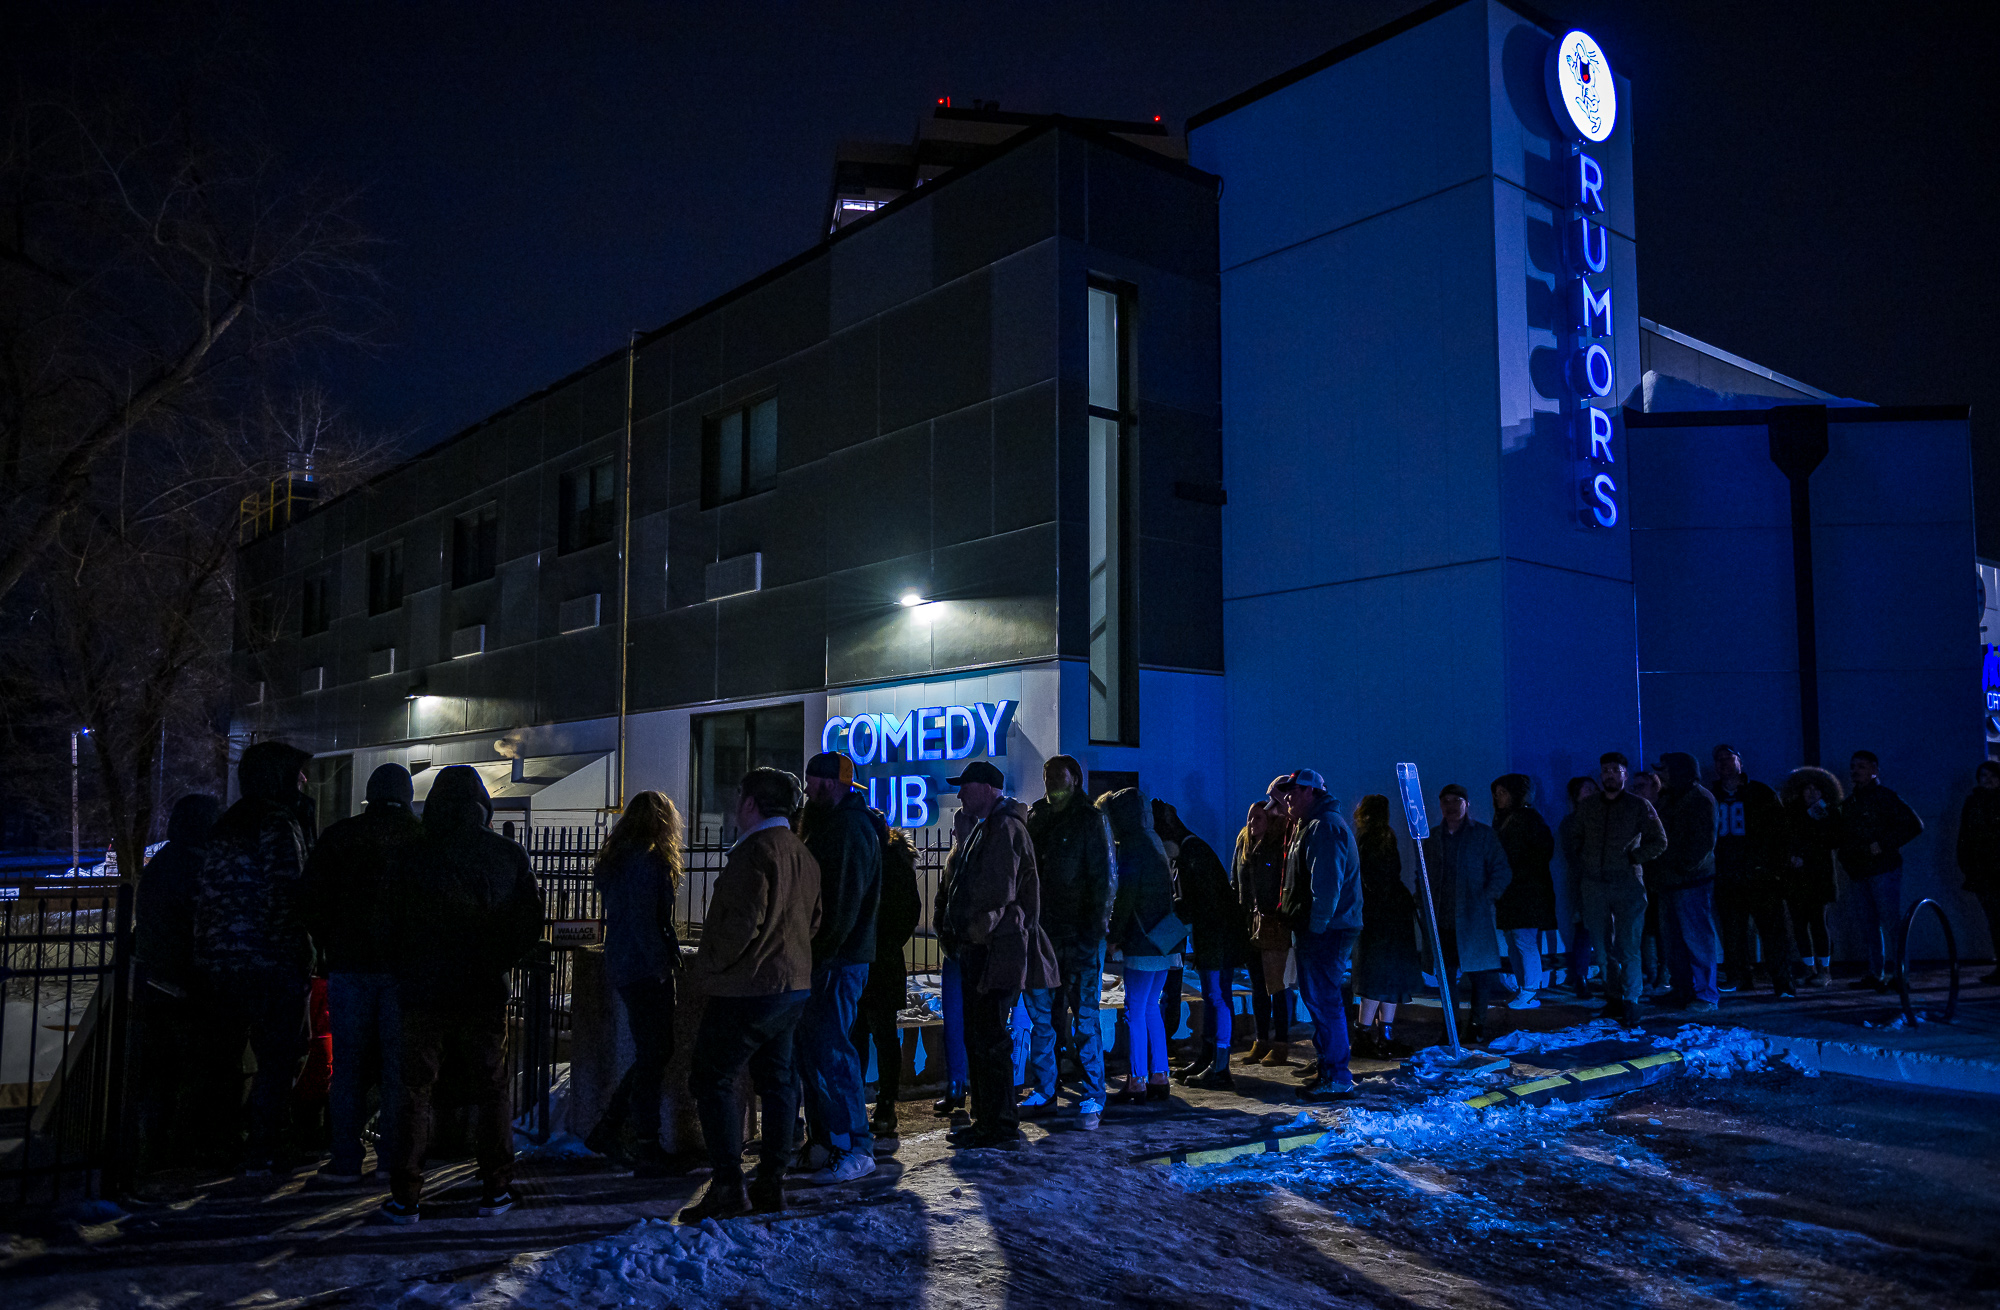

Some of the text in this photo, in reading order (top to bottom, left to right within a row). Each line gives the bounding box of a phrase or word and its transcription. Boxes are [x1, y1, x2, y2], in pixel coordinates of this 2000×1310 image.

[1579, 152, 1617, 527] RUMORS
[821, 699, 1010, 766] COMEDY
[868, 775, 930, 828] UB
